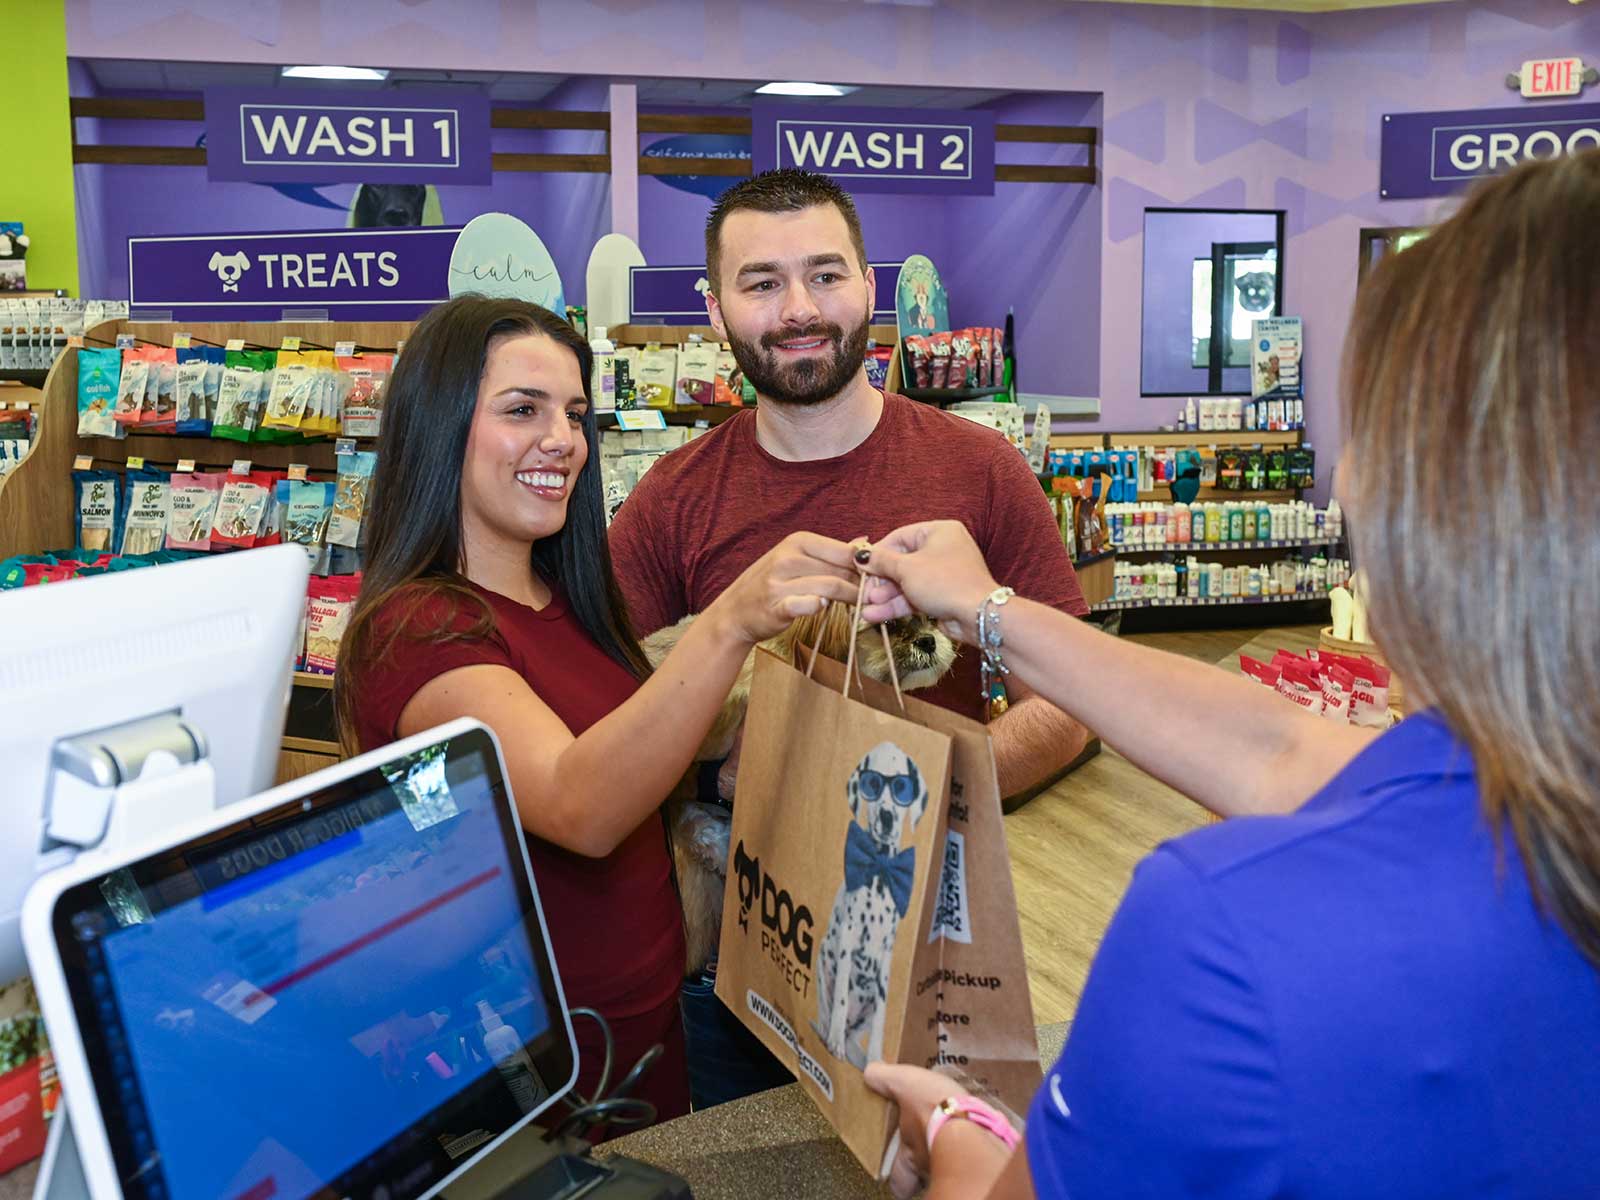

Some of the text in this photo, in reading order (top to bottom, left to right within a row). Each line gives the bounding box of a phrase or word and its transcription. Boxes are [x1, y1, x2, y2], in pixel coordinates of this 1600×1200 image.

[1531, 61, 1575, 93] EXIT
[251, 114, 450, 158] WASH 1
[785, 130, 964, 170] WASH 2
[258, 251, 399, 288] TREATS
[451, 254, 553, 281] calm
[82, 508, 111, 516] SALMON
[310, 606, 338, 617] OLLAGEN
[761, 872, 814, 969] DOG
[761, 930, 812, 999] PERFECT
[943, 969, 1001, 991] Pickup
